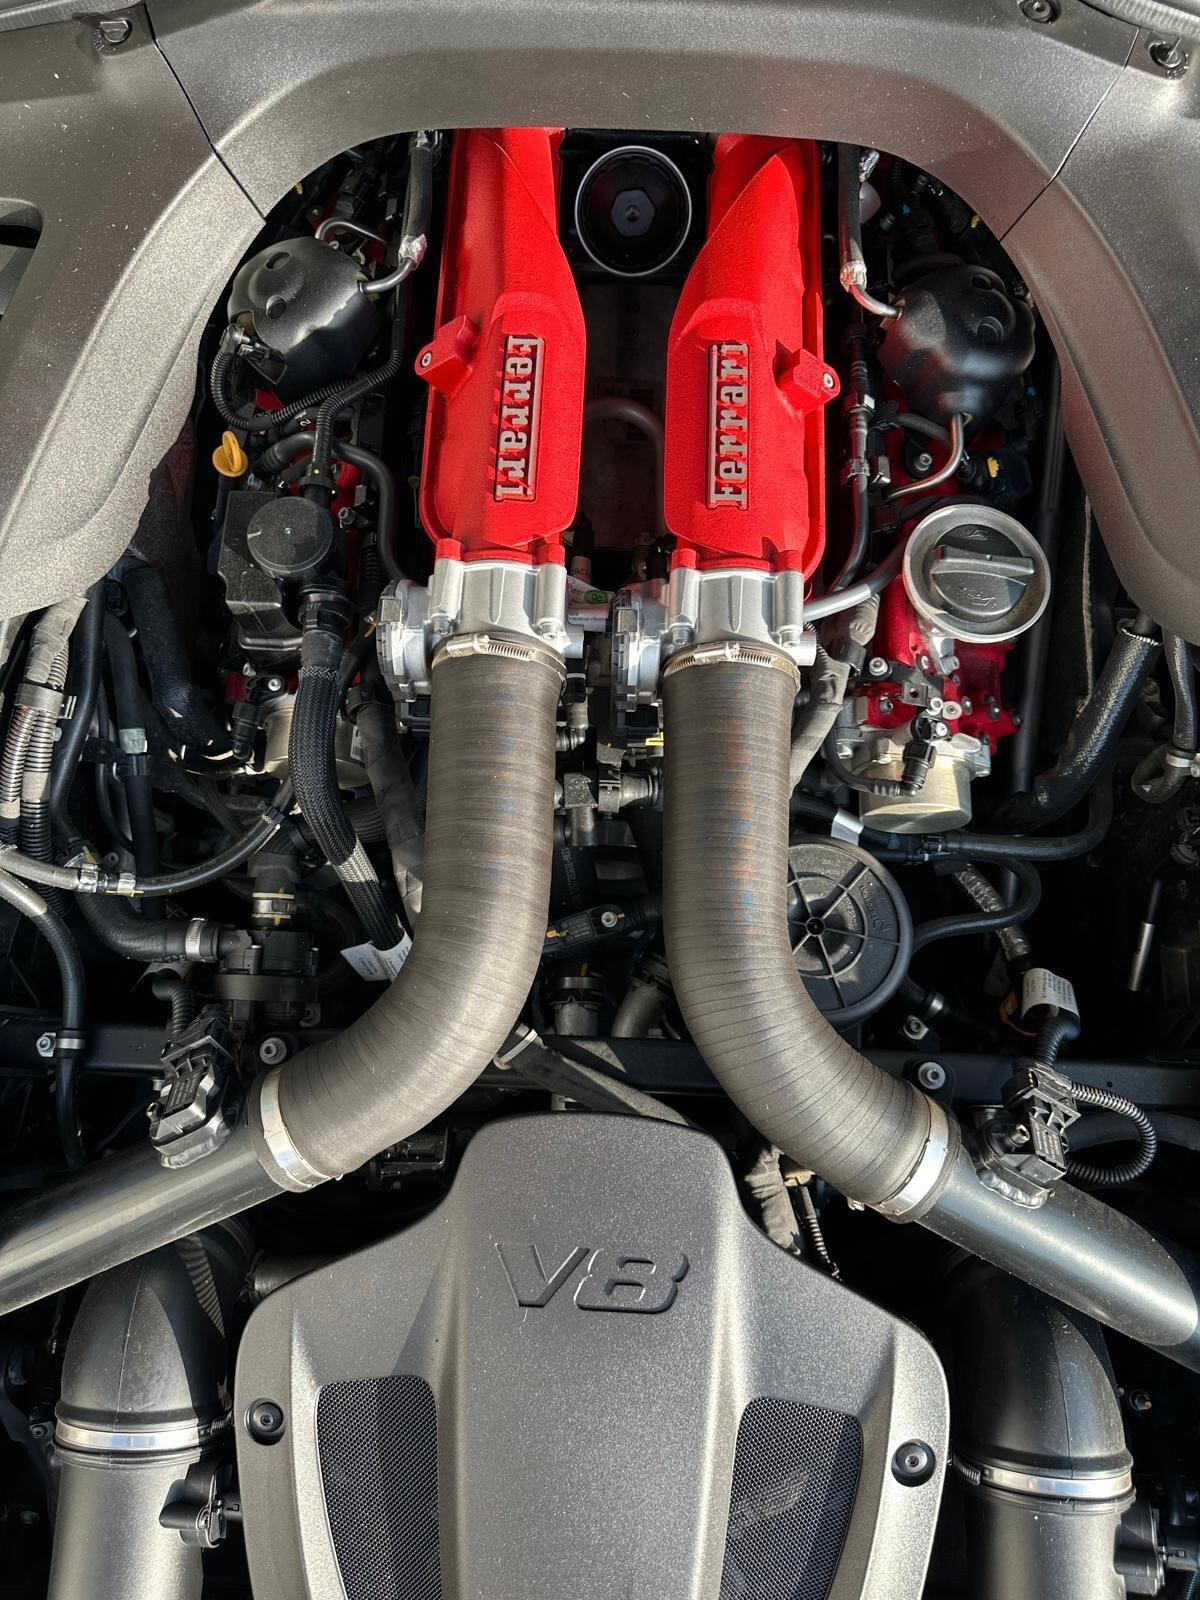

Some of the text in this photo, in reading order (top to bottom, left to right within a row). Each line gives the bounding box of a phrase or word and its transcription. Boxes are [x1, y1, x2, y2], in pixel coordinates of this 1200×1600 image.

[495, 334, 546, 501] Ferrari
[710, 342, 749, 509] Ferrari
[494, 1243, 691, 1315] V8
